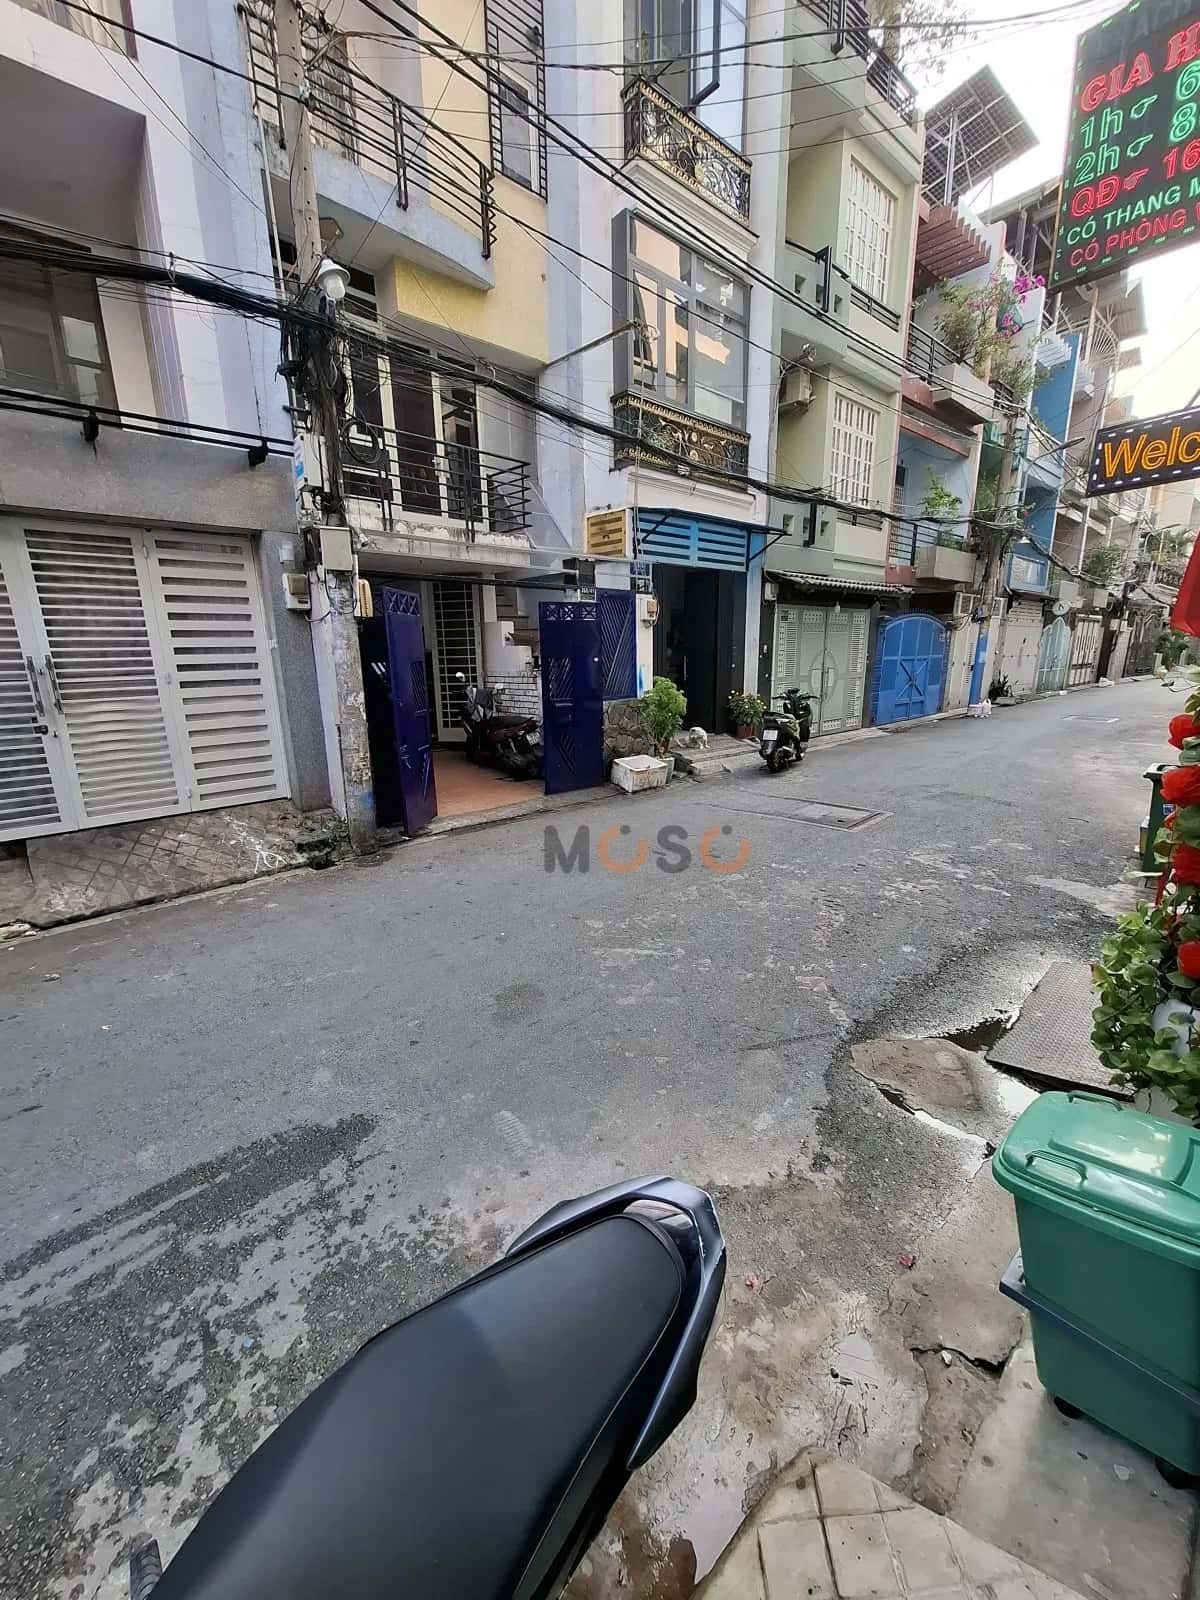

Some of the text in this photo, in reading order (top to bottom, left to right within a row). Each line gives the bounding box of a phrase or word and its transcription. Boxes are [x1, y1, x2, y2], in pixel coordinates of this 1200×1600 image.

[1080, 52, 1153, 112] GIA
[1080, 107, 1124, 149] 1h
[1074, 143, 1121, 188] 2h
[1066, 215, 1097, 246] CÓ
[1103, 185, 1181, 231] THANG
[1070, 174, 1122, 218] QĐ
[1070, 239, 1100, 267] CÓ
[1105, 208, 1187, 255] PHÒNG
[1103, 426, 1200, 478] Welc
